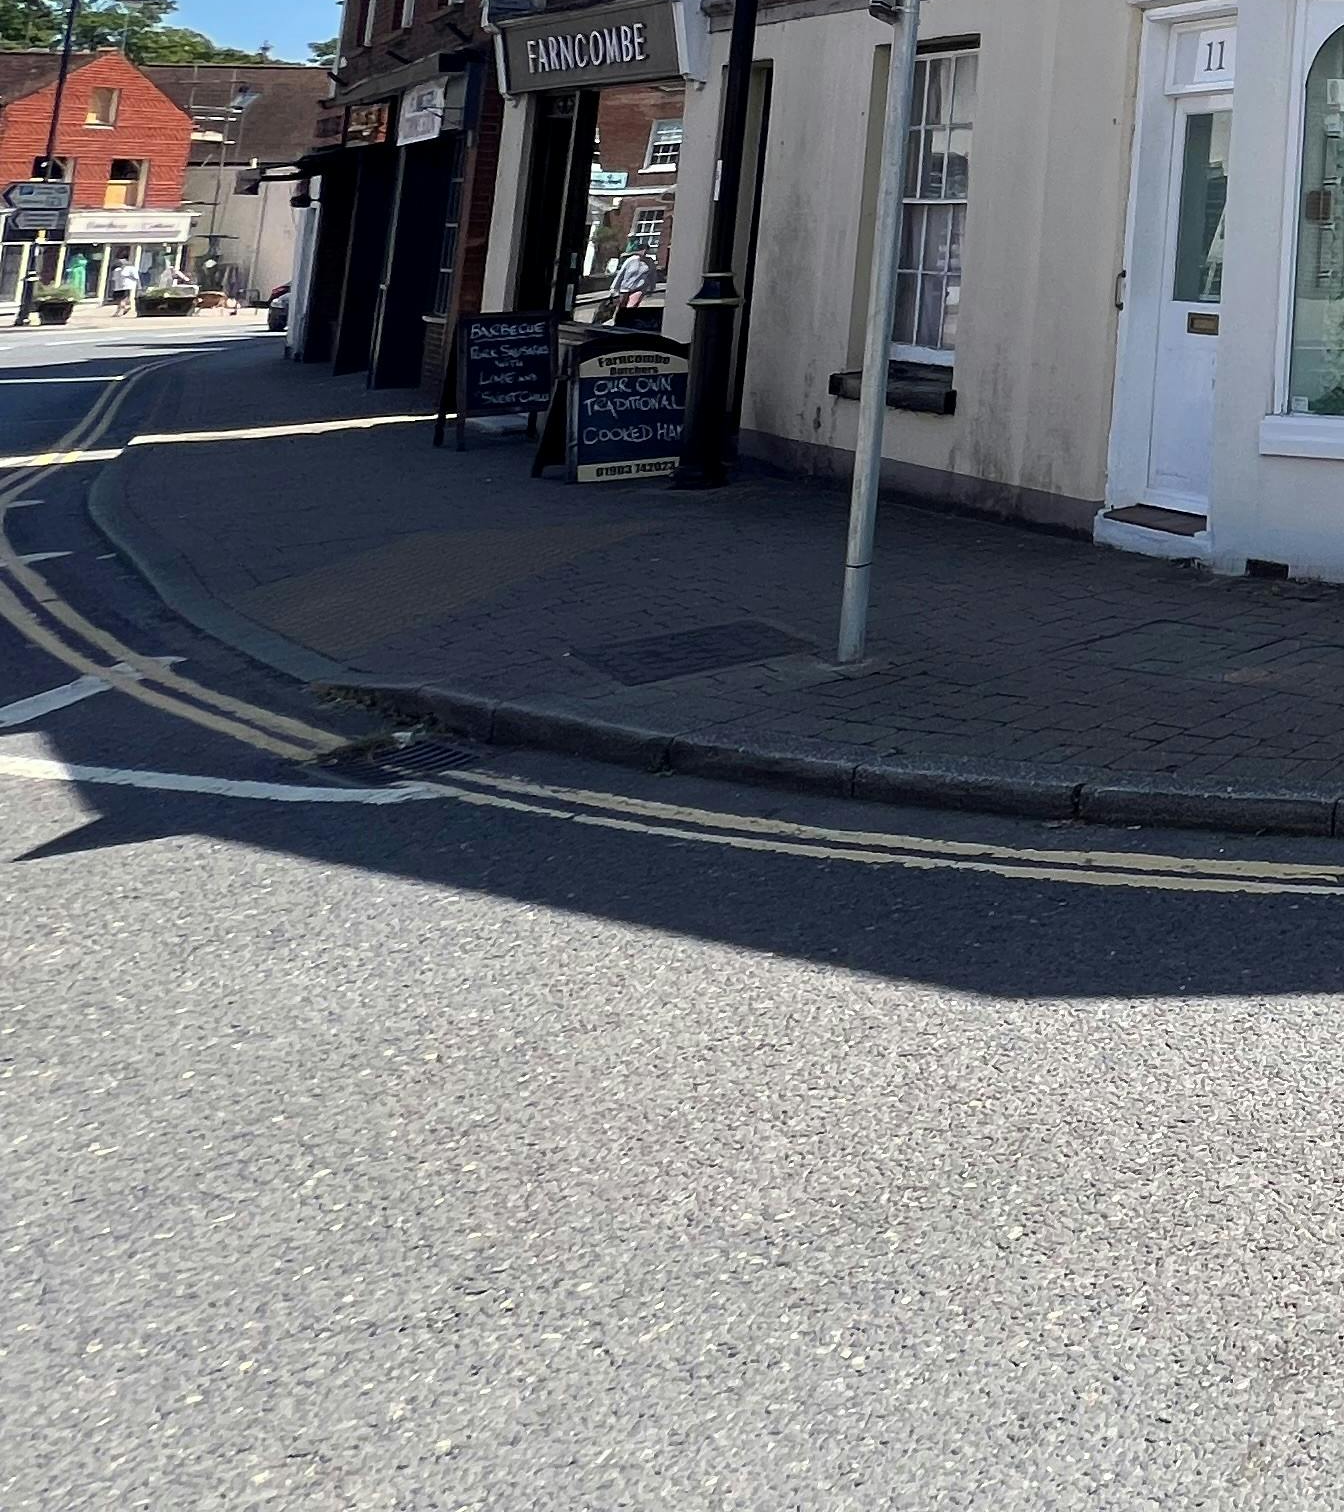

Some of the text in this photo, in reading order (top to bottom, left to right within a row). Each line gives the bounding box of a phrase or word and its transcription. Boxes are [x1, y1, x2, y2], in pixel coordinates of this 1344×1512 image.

[526, 22, 649, 74] FARNCOMBE
[1204, 39, 1225, 72] 11
[470, 322, 546, 339] BARBECUE
[597, 354, 671, 368] Farncombe
[609, 366, 659, 376] Butchers
[593, 374, 672, 395] OUR OWN
[583, 394, 686, 419] TRADITIONAL
[583, 424, 653, 445] COOKED
